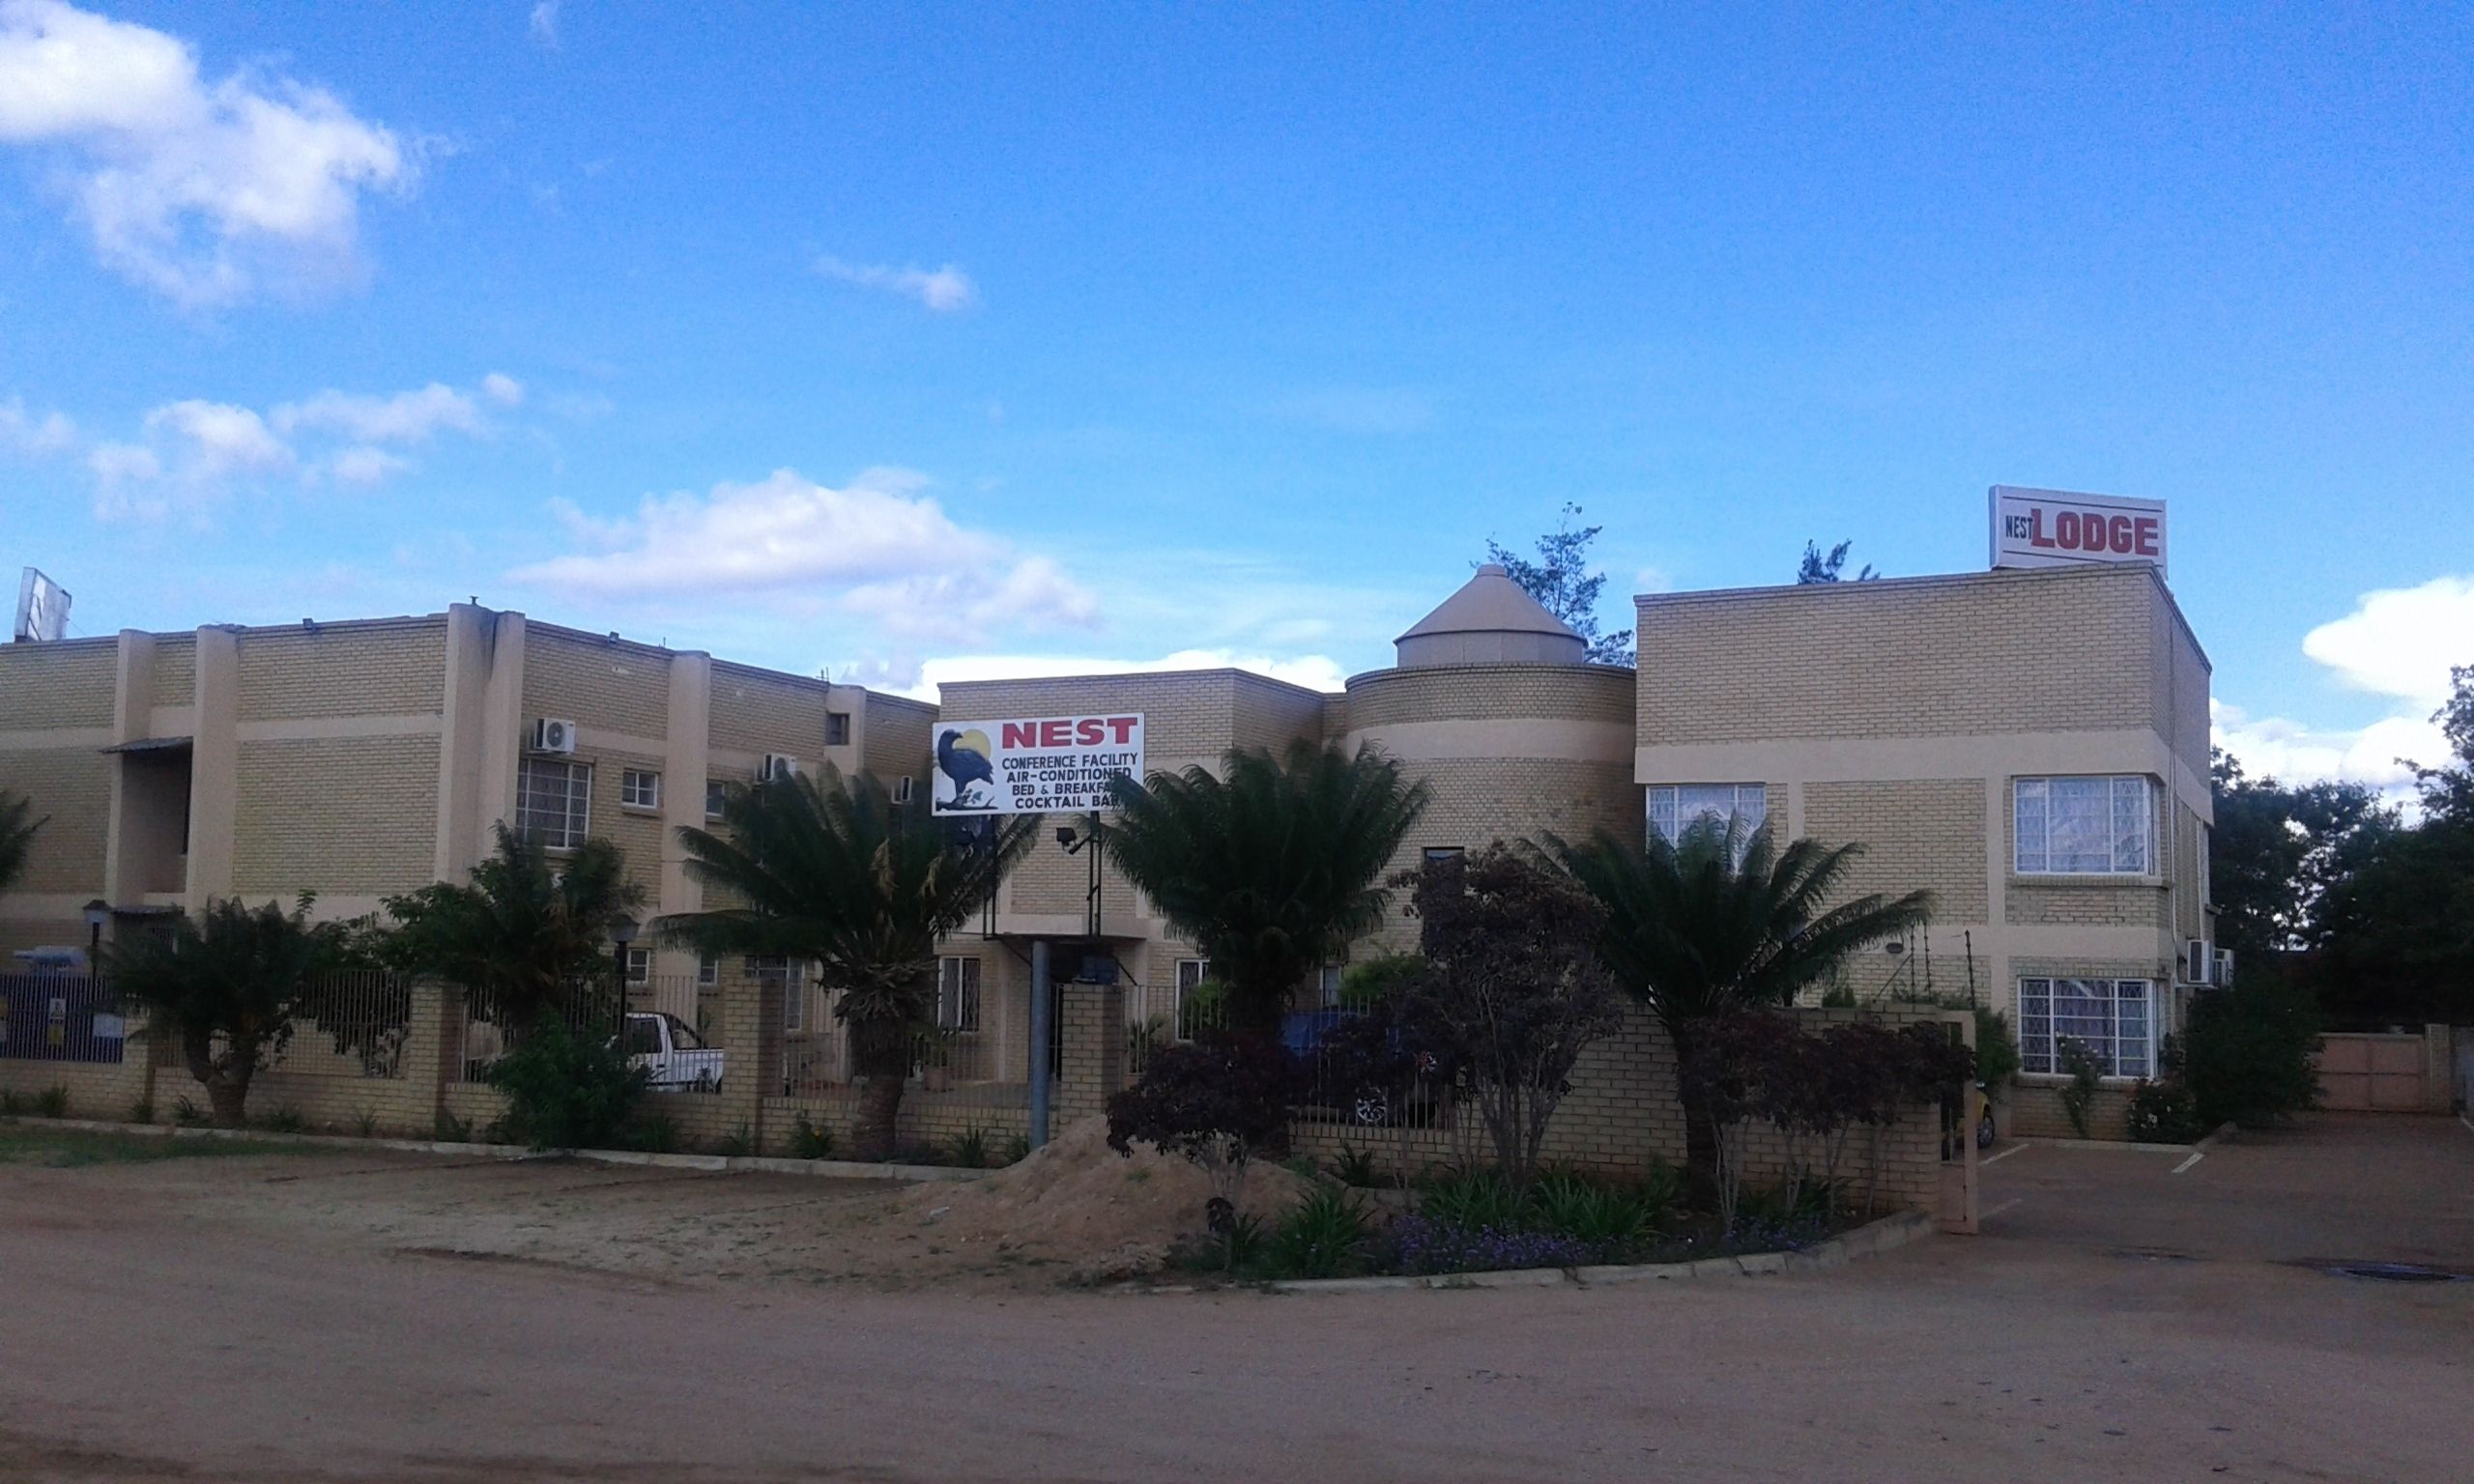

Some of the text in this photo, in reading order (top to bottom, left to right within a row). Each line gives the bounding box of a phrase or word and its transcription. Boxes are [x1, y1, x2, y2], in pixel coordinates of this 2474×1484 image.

[2005, 508, 2159, 556] NEST LODGE
[1002, 718, 1137, 749] NEST
[1001, 753, 1137, 770] CONFERENCE FACILITY
[1007, 767, 1132, 784] AIR-CONDITIONED
[1012, 783, 1112, 796] BED & BREAKFA
[1015, 796, 1084, 809] COCKTAIL
